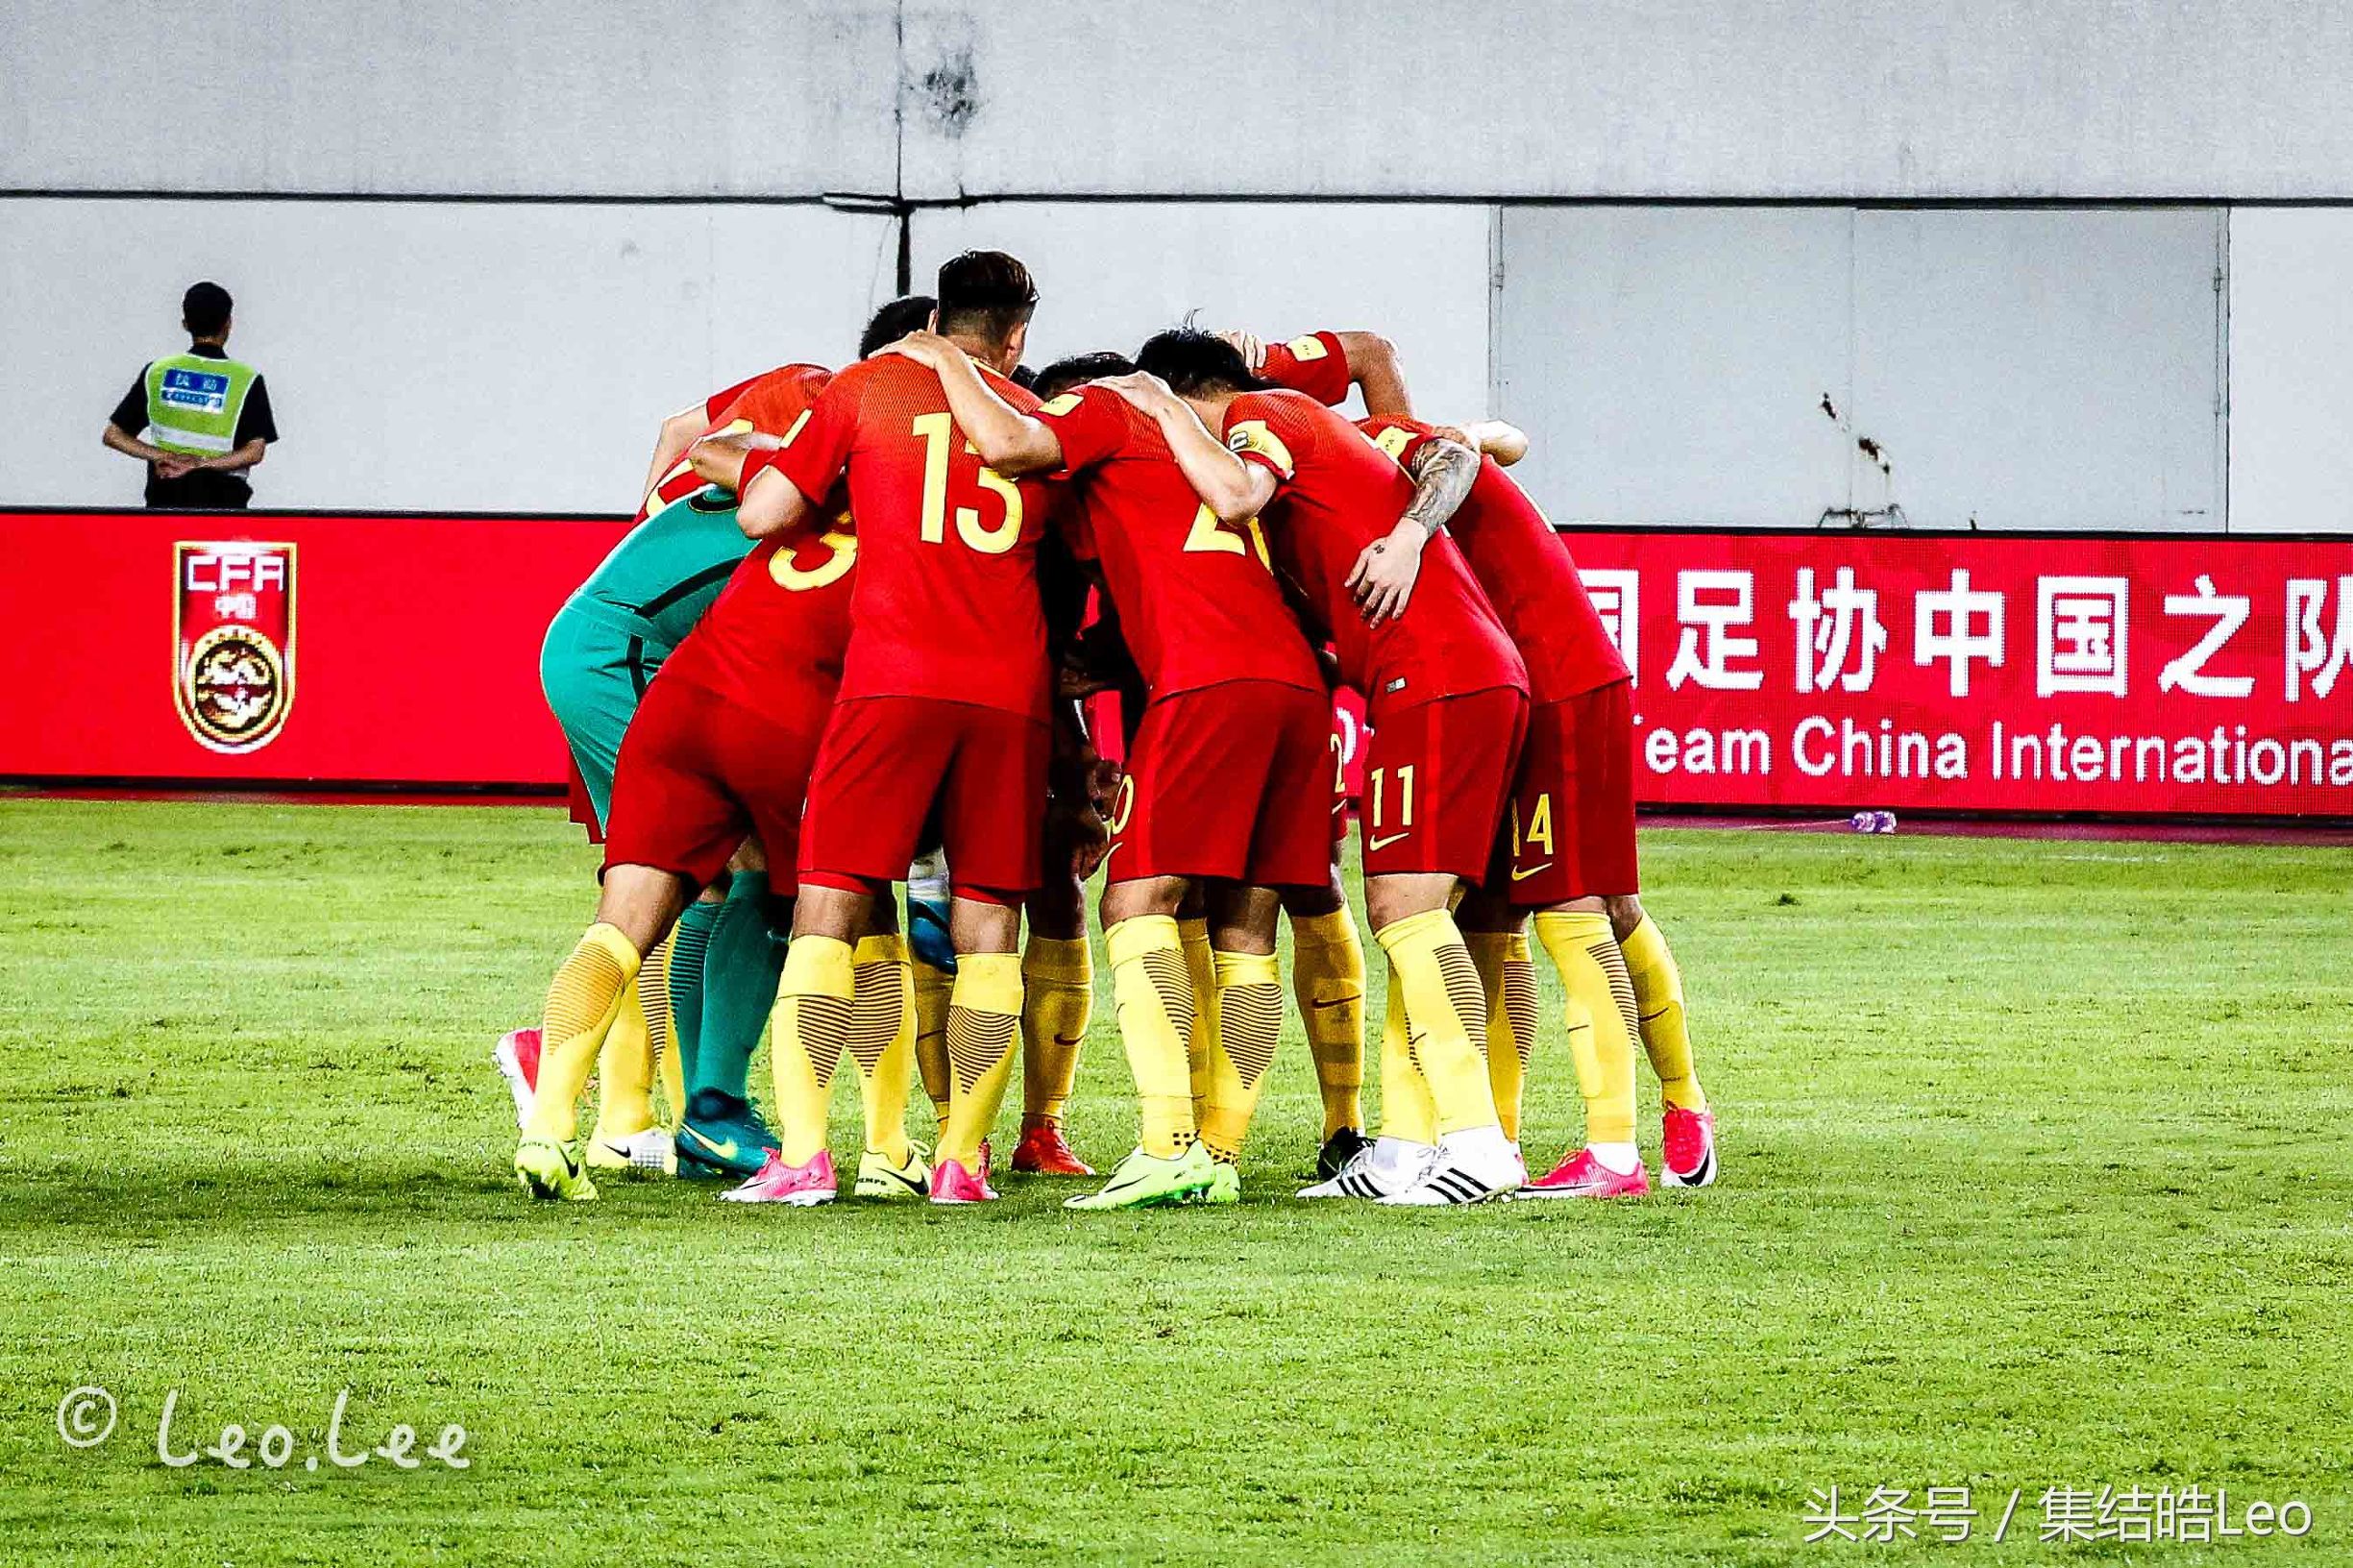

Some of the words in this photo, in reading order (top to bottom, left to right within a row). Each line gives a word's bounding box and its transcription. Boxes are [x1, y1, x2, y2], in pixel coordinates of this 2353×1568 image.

[912, 412, 1023, 554] 13
[187, 555, 284, 591] CFA
[1632, 713, 1771, 776] eam
[1793, 715, 1968, 779] China
[1371, 765, 1414, 826] 11
